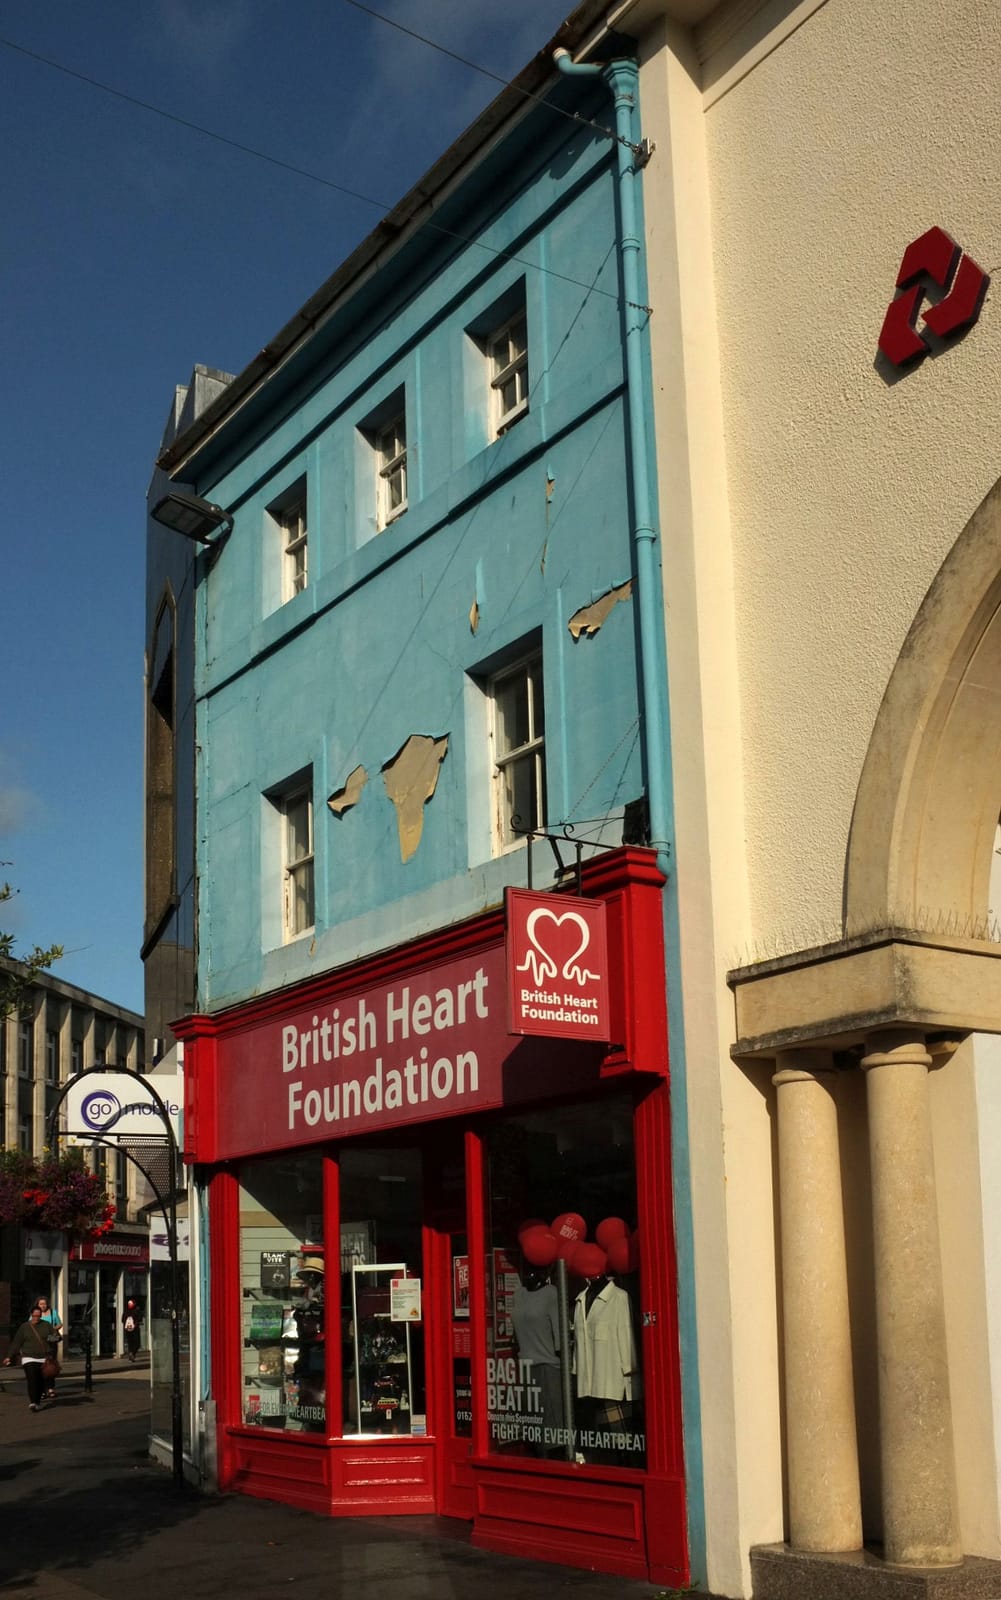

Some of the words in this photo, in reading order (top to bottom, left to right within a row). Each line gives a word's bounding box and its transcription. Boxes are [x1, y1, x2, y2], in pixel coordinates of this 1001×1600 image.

[521, 989, 561, 1005] British
[563, 993, 598, 1009] Heart
[281, 999, 378, 1073] British
[386, 967, 489, 1044] Heart
[521, 1004, 599, 1025] Foundation
[288, 1047, 479, 1130] Foundation
[90, 1103, 112, 1120] go
[125, 1099, 179, 1116] moble
[487, 1358, 516, 1384] BAG
[519, 1359, 536, 1385] IT.
[487, 1385, 524, 1412] BEAT
[527, 1386, 544, 1414] IT.
[292, 1405, 326, 1421] HEARTBEA
[515, 1413, 544, 1425] September
[492, 1423, 520, 1441] FIGHT
[522, 1426, 542, 1443] FOR
[544, 1427, 577, 1446] EVERY
